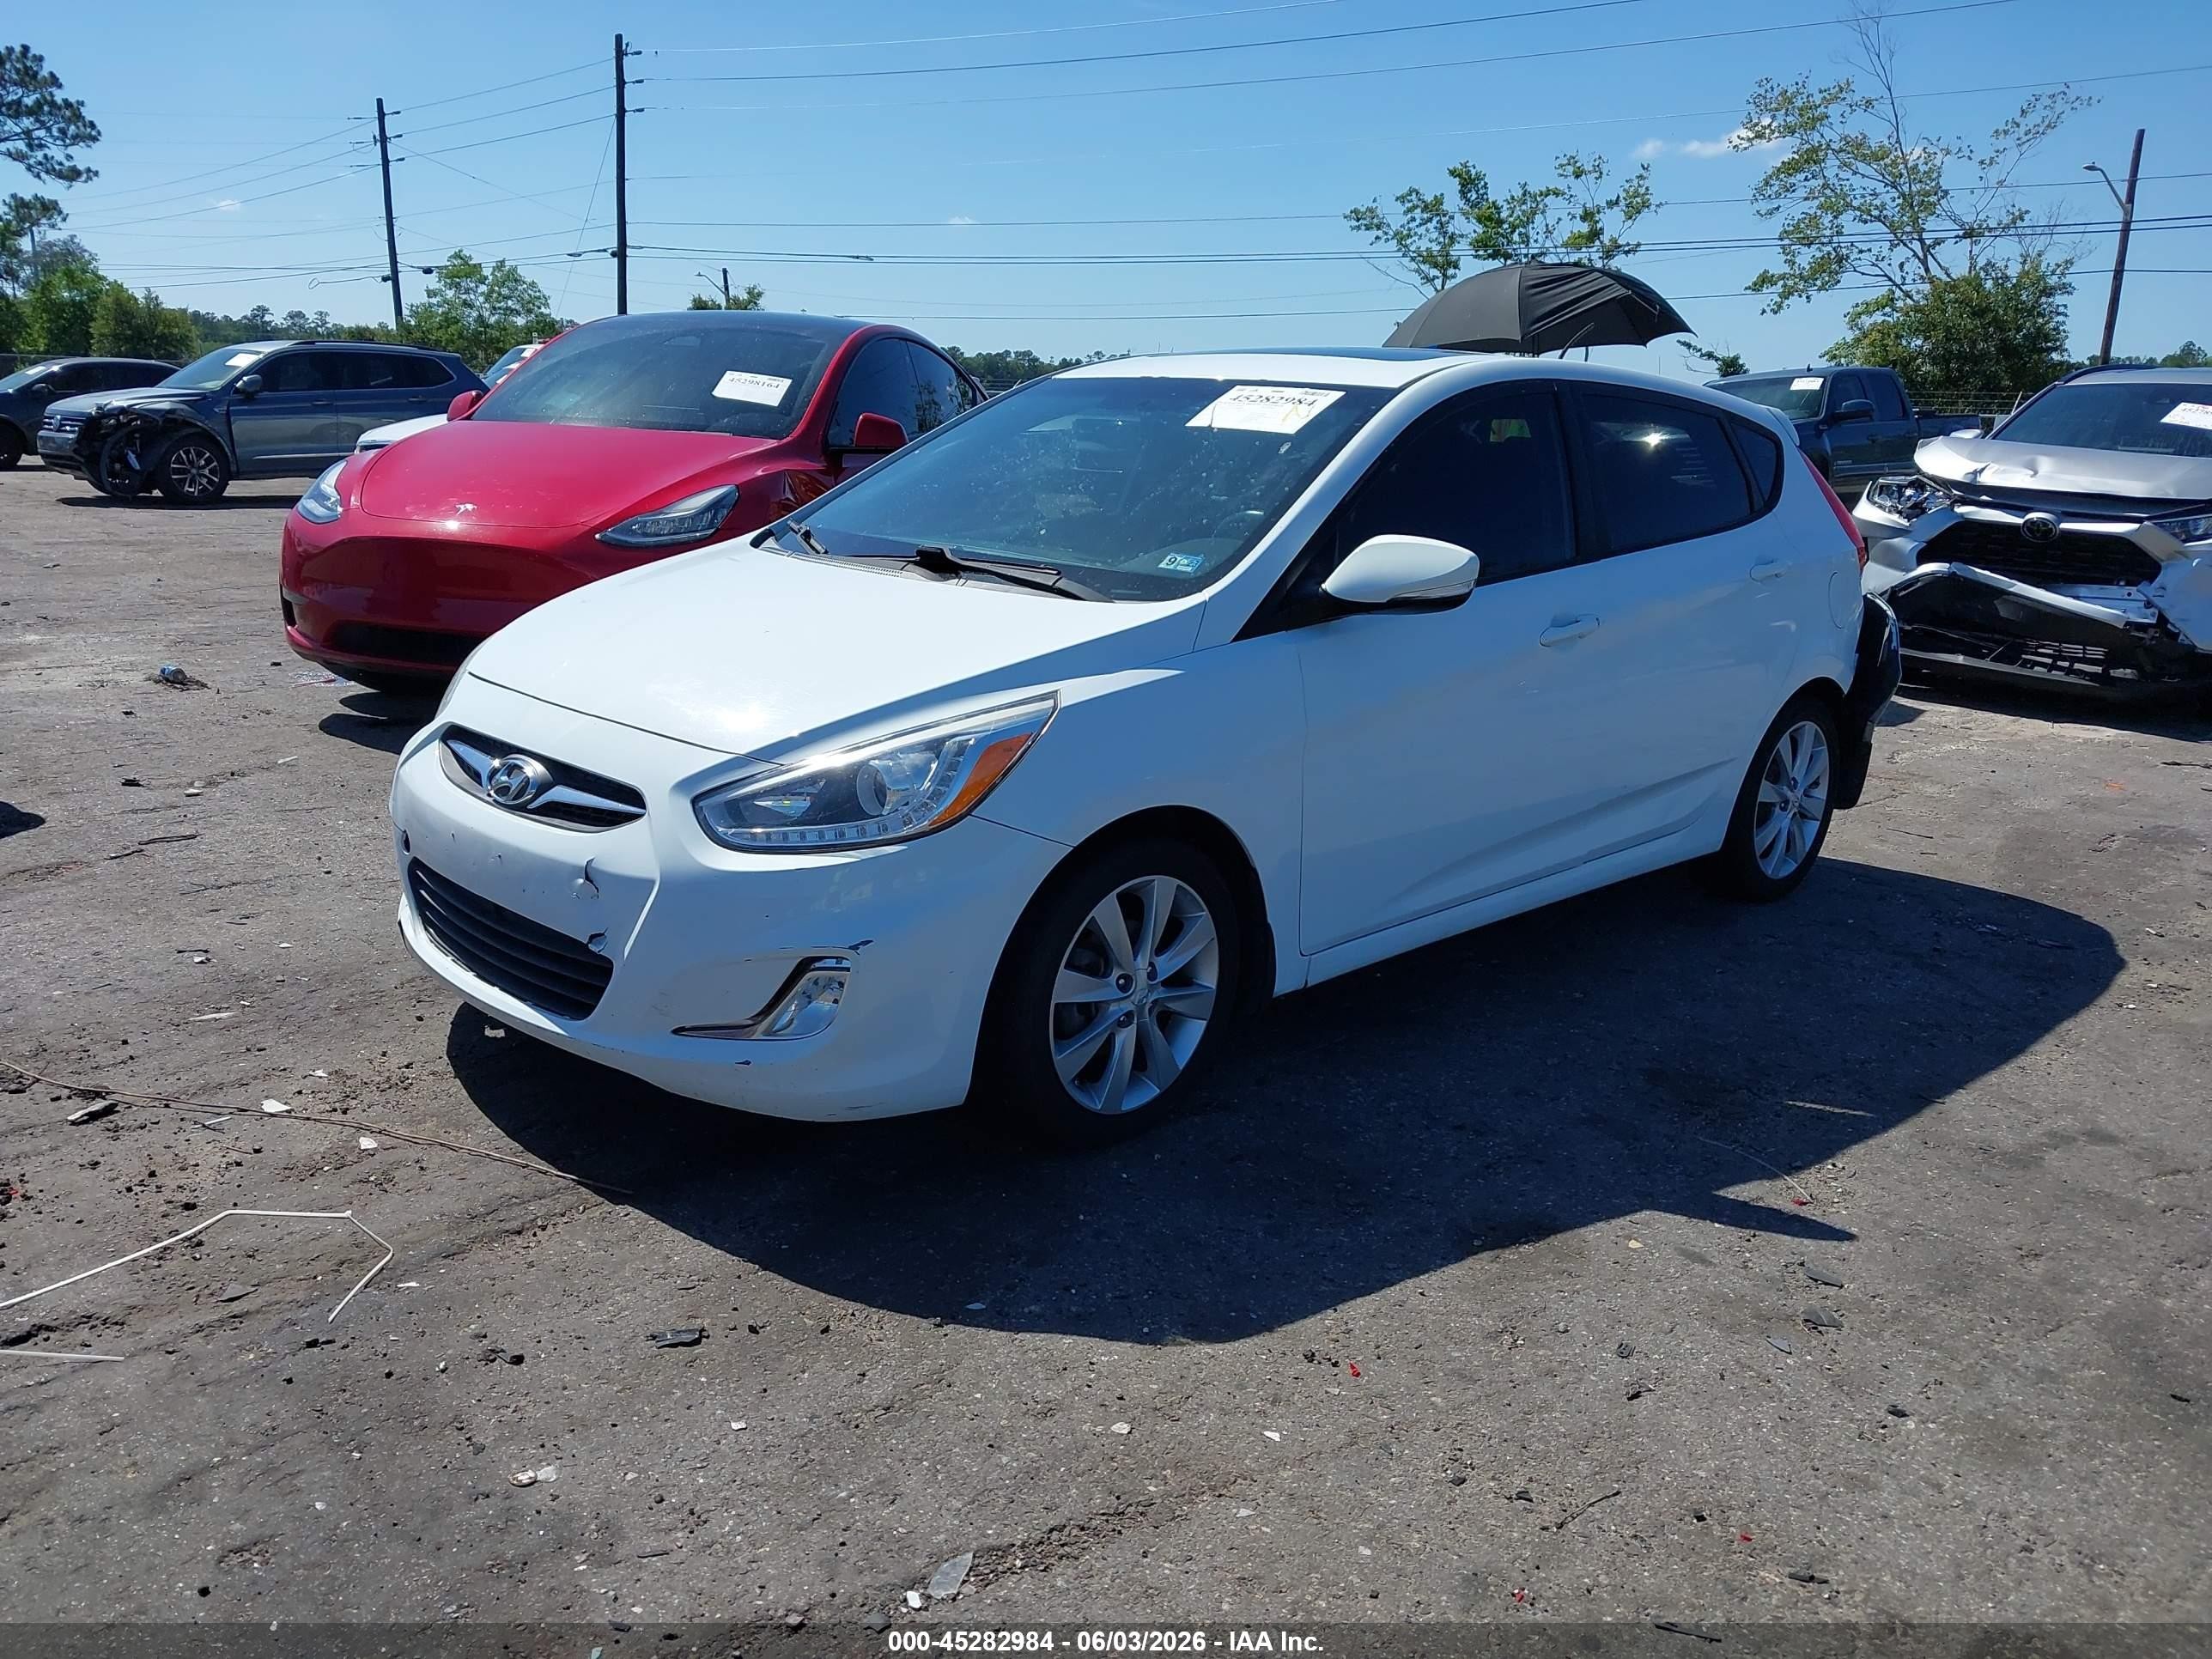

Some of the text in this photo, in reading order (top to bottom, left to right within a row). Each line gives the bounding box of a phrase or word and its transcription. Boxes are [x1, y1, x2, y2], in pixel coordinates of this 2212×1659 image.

[728, 377, 781, 389] 45298164
[1229, 393, 1319, 407] 45282984
[1166, 556, 1177, 566] 9
